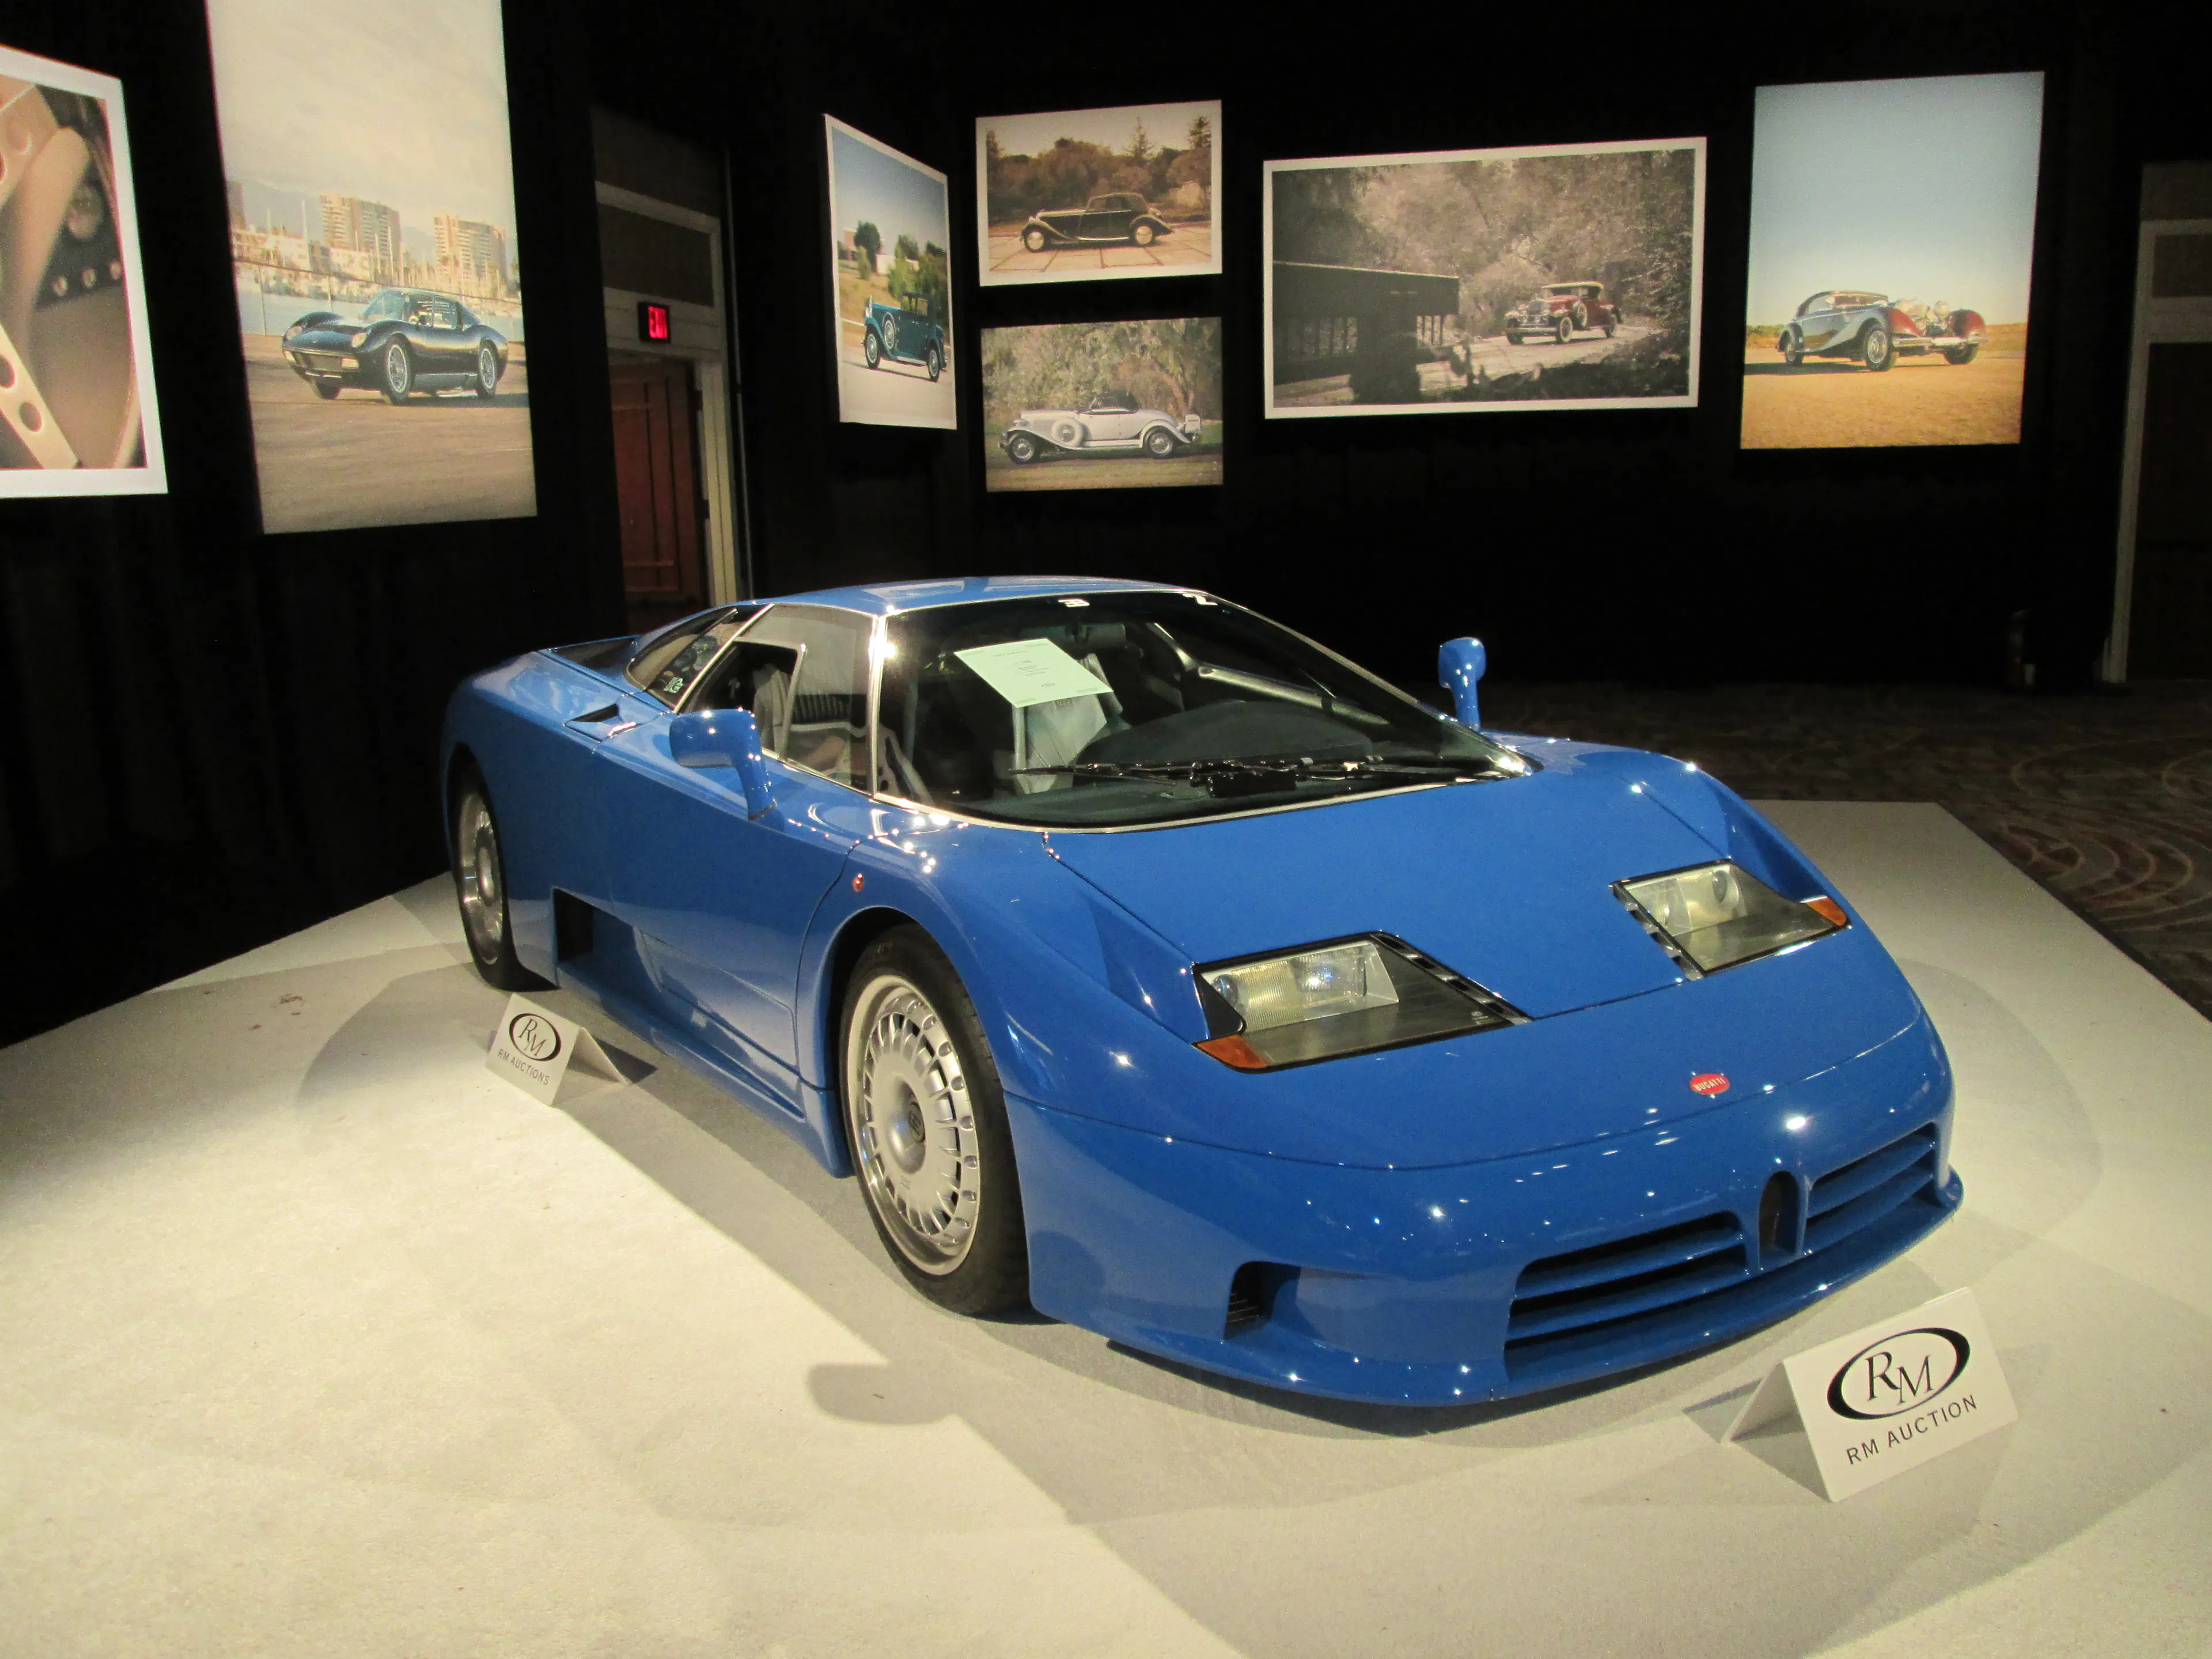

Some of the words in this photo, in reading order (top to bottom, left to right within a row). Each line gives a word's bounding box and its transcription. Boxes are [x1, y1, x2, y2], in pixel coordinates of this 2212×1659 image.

[498, 1048, 509, 1060] RM
[511, 1057, 549, 1085] AUCTIONS
[1694, 1077, 1726, 1091] BUGATTI
[1865, 1351, 1934, 1406] RM
[1846, 1439, 1879, 1464] RM
[1888, 1394, 1978, 1448] AUCTION
